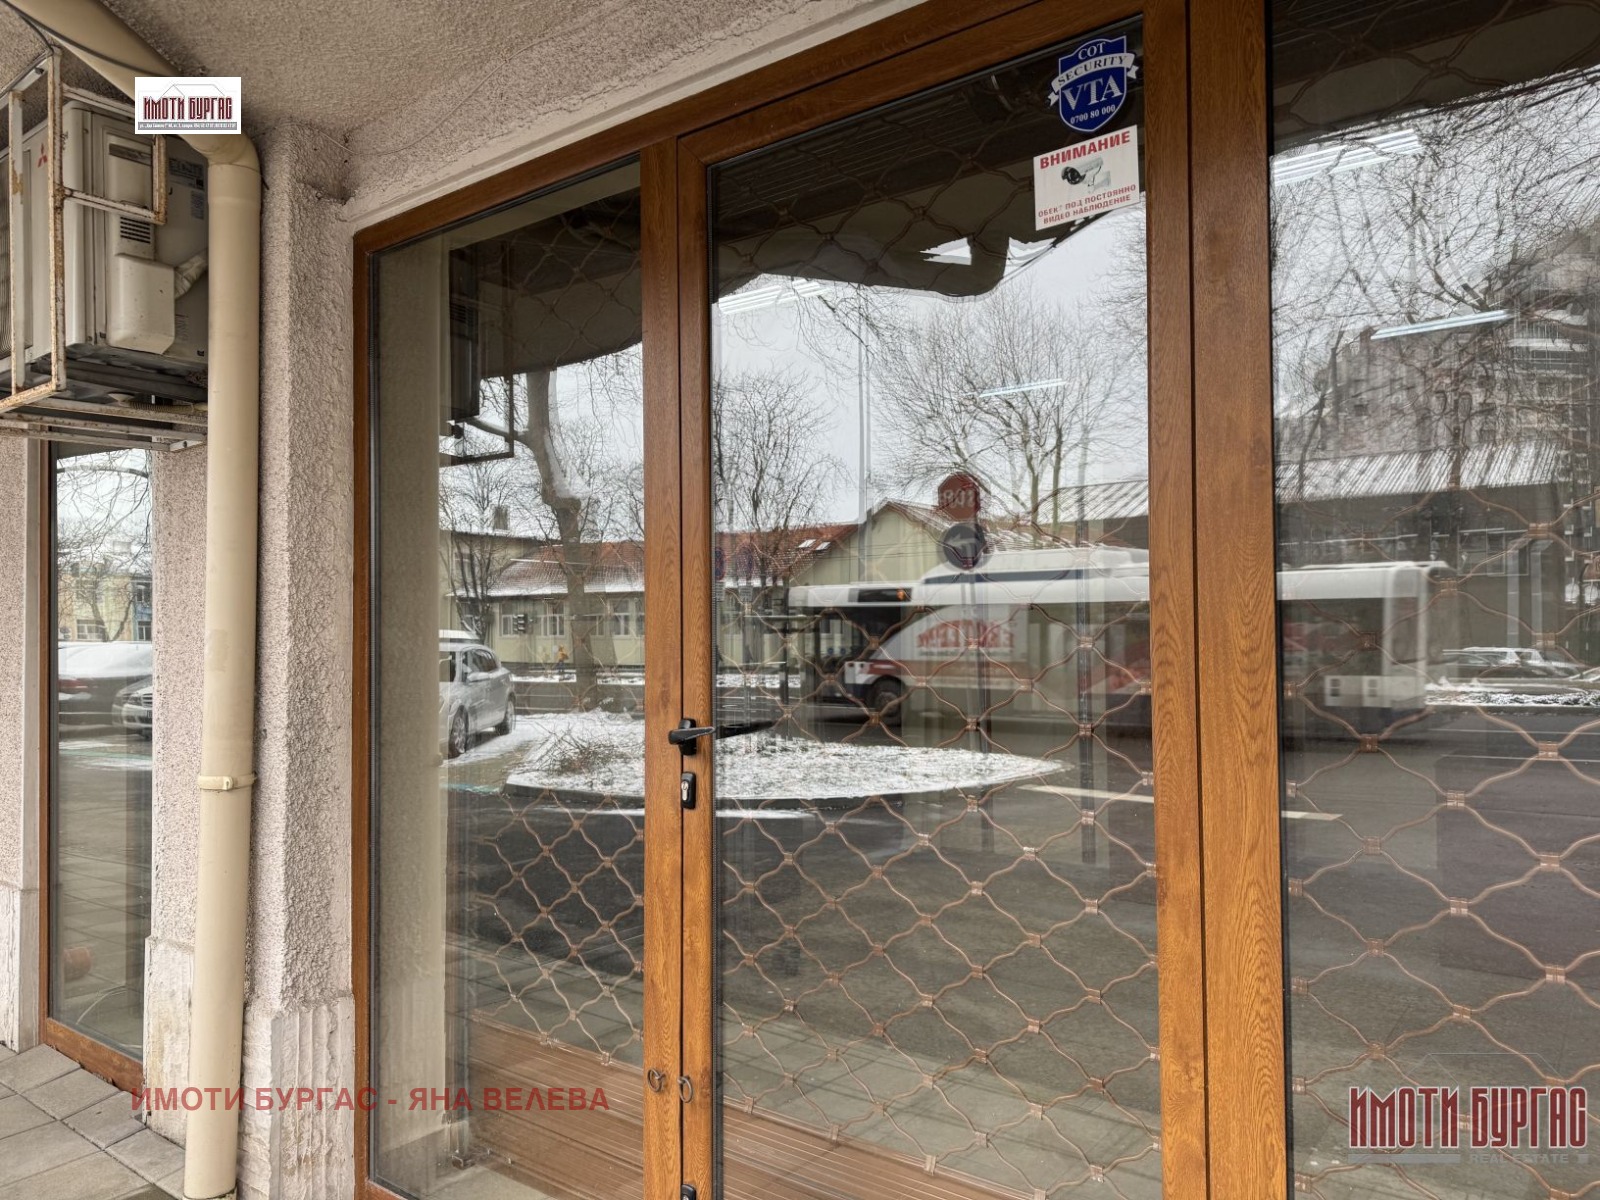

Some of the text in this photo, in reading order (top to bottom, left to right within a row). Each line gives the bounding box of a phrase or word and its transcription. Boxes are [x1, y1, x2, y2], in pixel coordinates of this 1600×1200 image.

[1058, 55, 1127, 86] SECURITY
[1062, 74, 1123, 111] VTA
[1070, 104, 1116, 125] 0700 80 000
[1040, 130, 1131, 170] ВНИМАНИЕ
[1038, 204, 1063, 218] ОБЕК
[1085, 184, 1136, 204] ПОСТОЯННО
[1043, 194, 1131, 225] ВИДЕО НАБЛЮДЕНИЕ
